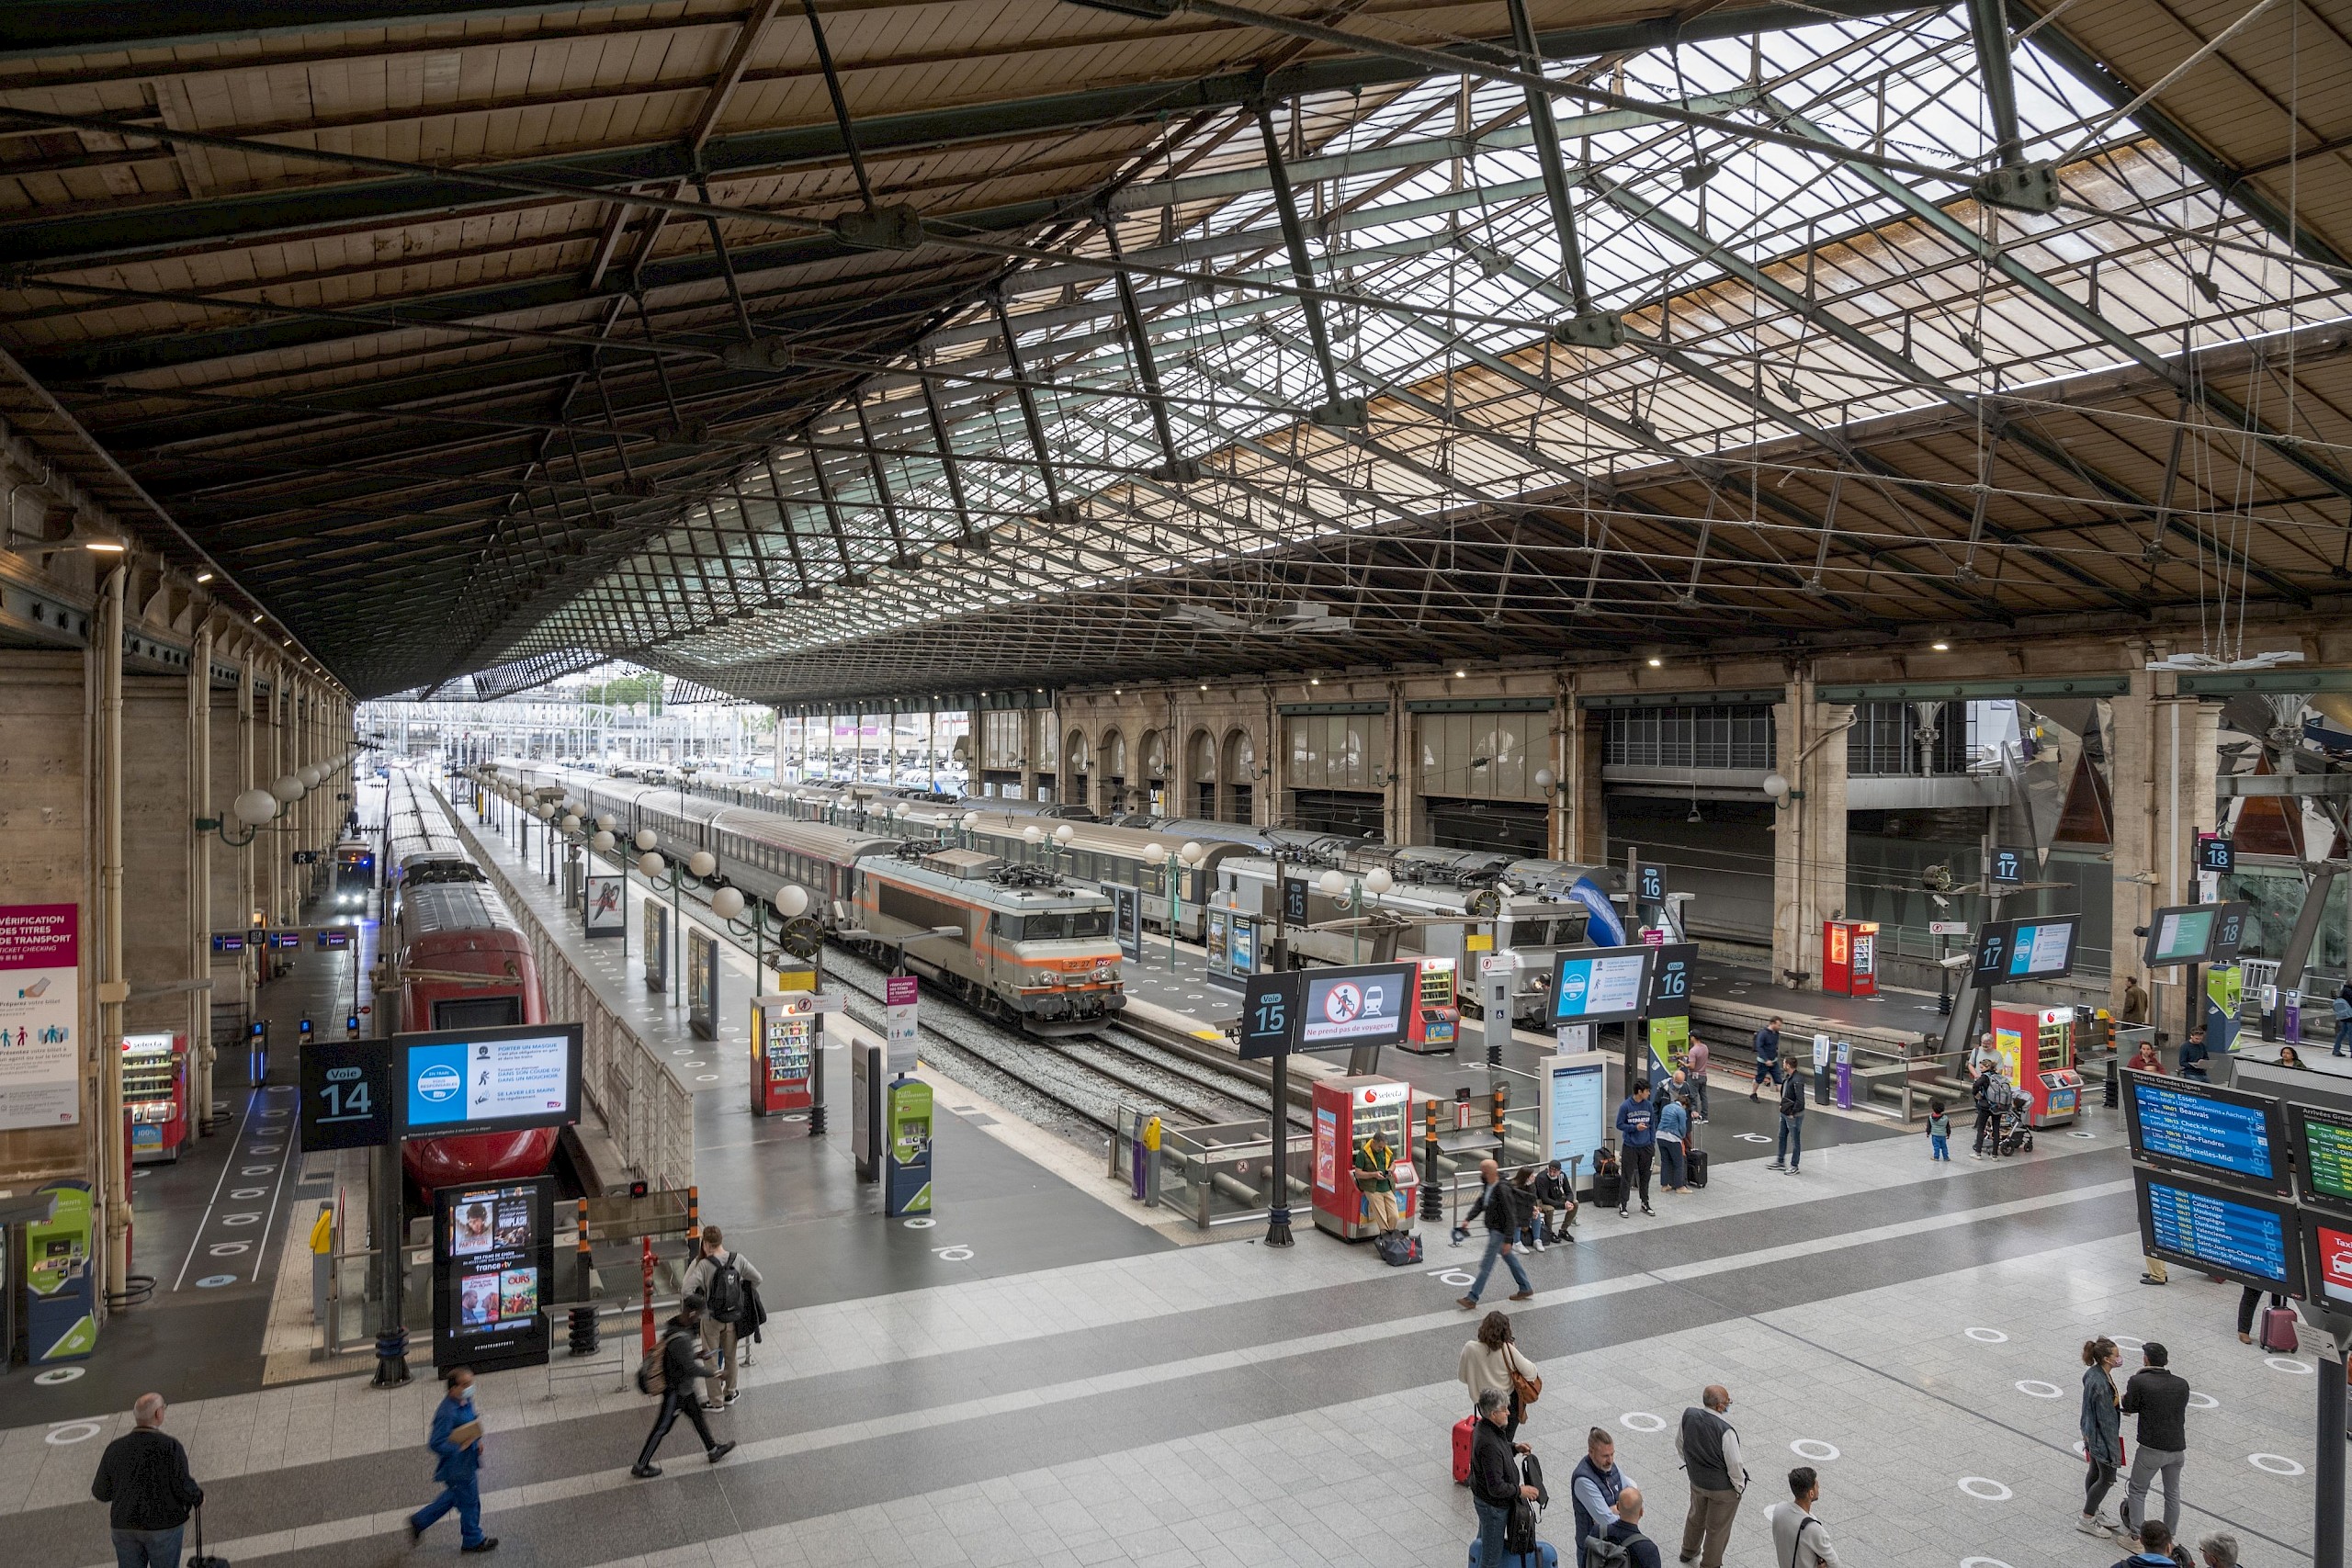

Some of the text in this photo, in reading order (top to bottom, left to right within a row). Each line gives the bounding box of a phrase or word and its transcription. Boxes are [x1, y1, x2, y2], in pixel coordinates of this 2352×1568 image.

[299, 853, 306, 863] R
[2208, 851, 2227, 864] 18
[1997, 861, 2018, 876] 17
[1643, 877, 1659, 897] 16
[1290, 894, 1303, 915] 15
[0, 916, 65, 926] VÉRIFICATION
[0, 926, 51, 935] DES TITRES
[2223, 924, 2238, 942] 18
[0, 934, 72, 945] DE TRANSPORT
[1984, 946, 2003, 966] 17
[1663, 972, 1686, 994] 16
[1255, 1005, 1284, 1031] 15
[331, 1069, 356, 1078] Voie
[2156, 1078, 2180, 1088] Grandes
[2182, 1083, 2200, 1091] Lignes
[320, 1082, 371, 1116] 14
[1379, 1090, 1401, 1099] selecta
[2177, 1094, 2197, 1103] Essen
[2154, 1108, 2177, 1117] Beauvais
[2179, 1107, 2209, 1119] Beauvais
[2226, 1111, 2246, 1120] Aachen
[2302, 1108, 2331, 1118] Arrivées
[2151, 1120, 2200, 1135] London-St-Pancras
[2181, 1121, 2209, 1131] Check-in
[2210, 1127, 2225, 1135] open
[2152, 1132, 2188, 1145] Lille-Flandres
[2183, 1134, 2224, 1148] Lille-Flandres
[2154, 1145, 2191, 1158] Bruxelles-Midi
[2185, 1146, 2233, 1163] Bruxelles-Midi
[2192, 1194, 2224, 1207] Amsterdam
[2193, 1201, 2223, 1213] Calais-Ville
[2193, 1208, 2222, 1219] Maubeuge
[2194, 1214, 2225, 1225] Compiègne
[498, 1216, 527, 1228] WHIPLASH
[2195, 1220, 2225, 1233] Dunkerque
[2196, 1226, 2233, 1240] Valenciennes
[2197, 1233, 2221, 1244] Beauvais
[459, 1240, 476, 1248] PARTY
[2197, 1239, 2264, 1262] Saint-Just-en-Chaussée
[2262, 1221, 2281, 1280] départs
[2198, 1246, 2251, 1264] London-St-Pancras
[2199, 1253, 2231, 1265] Amsterdam
[508, 1273, 530, 1284] OURS
